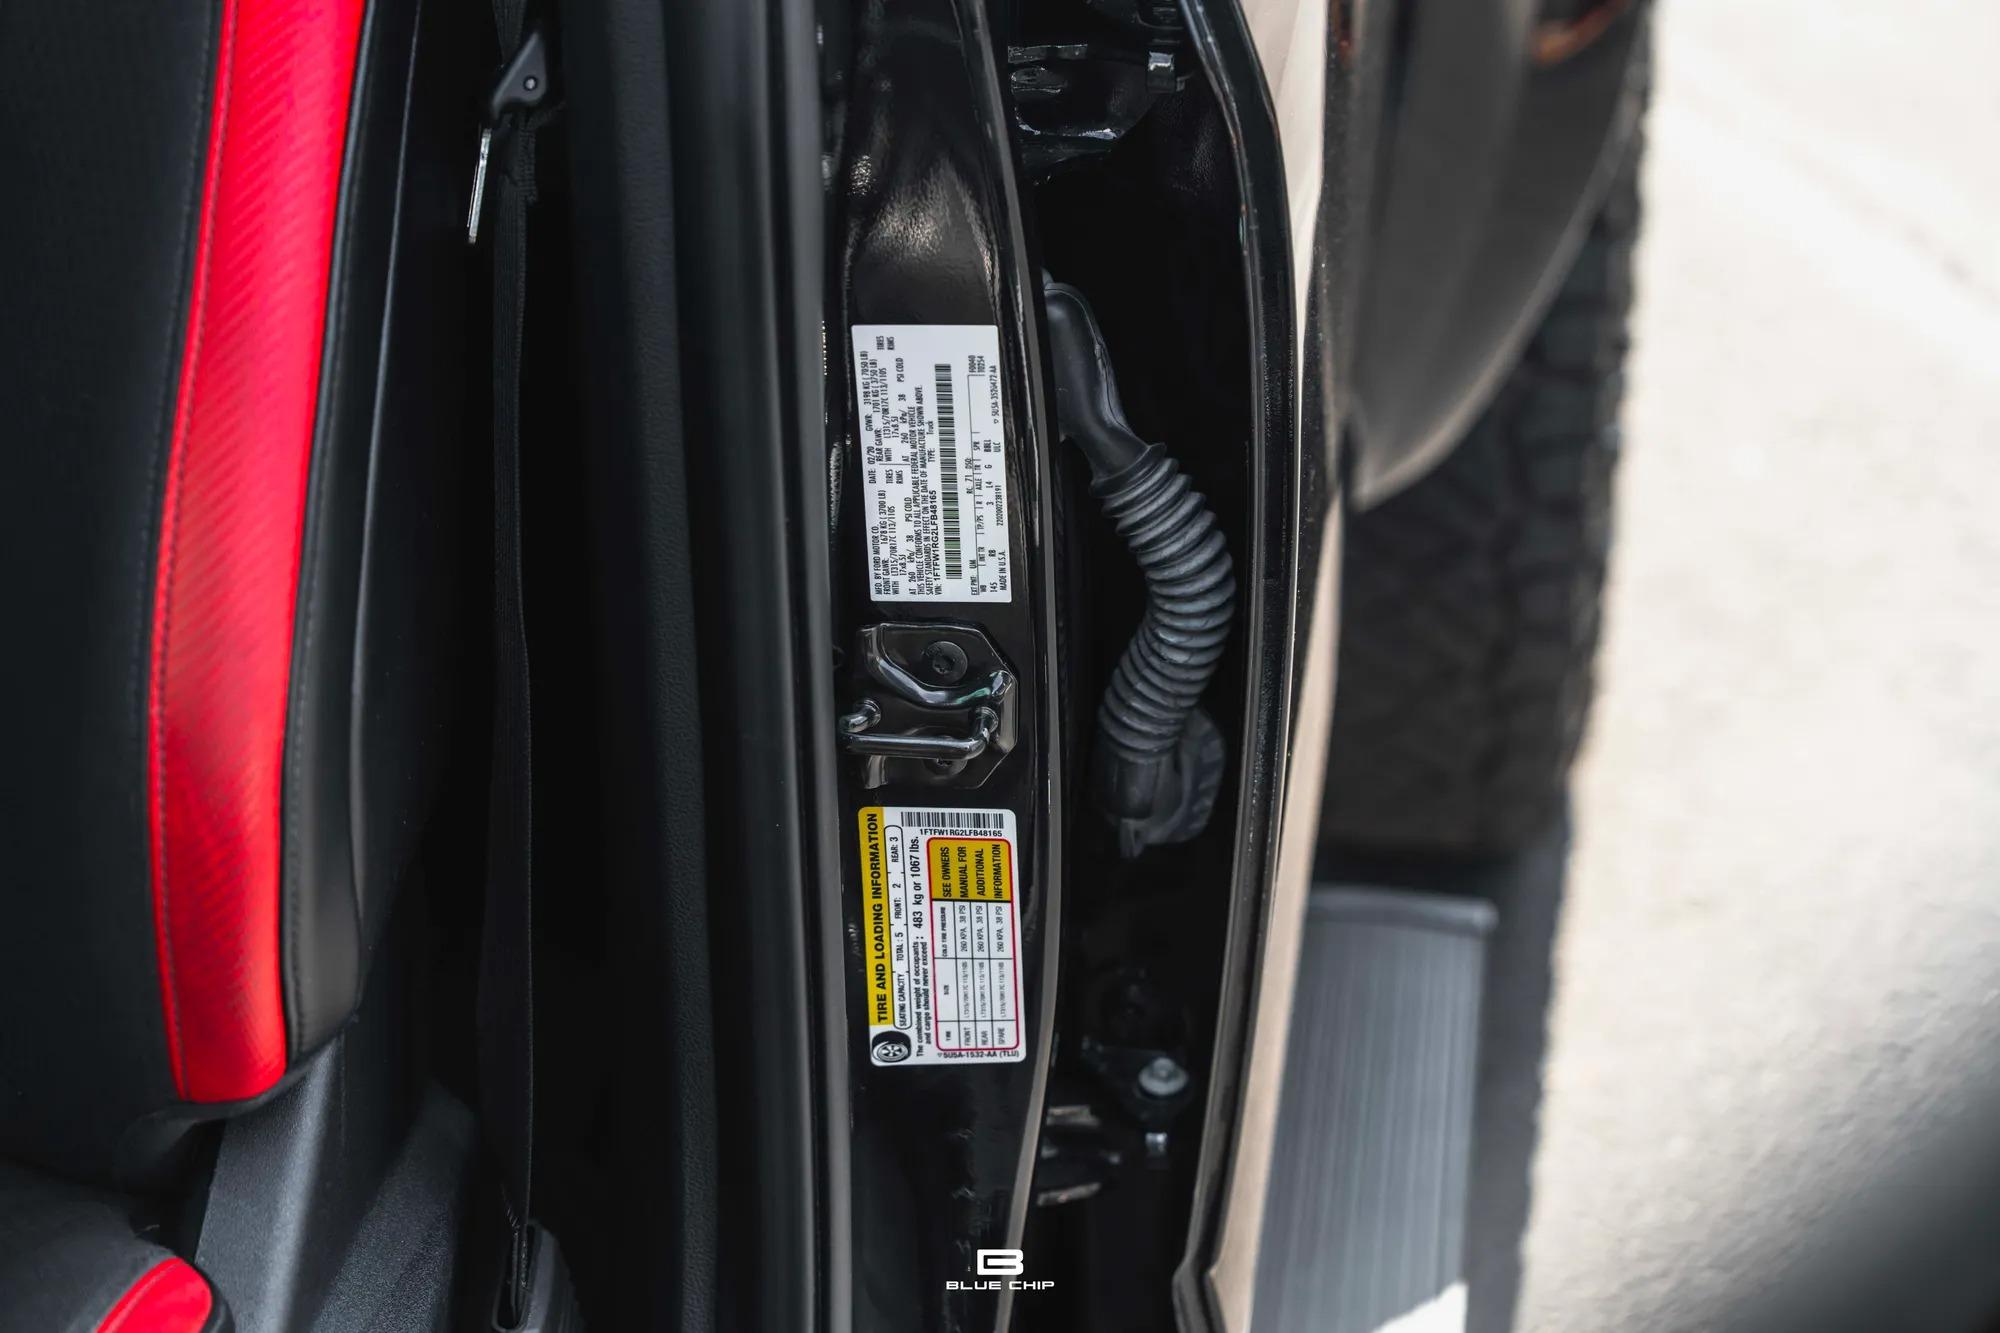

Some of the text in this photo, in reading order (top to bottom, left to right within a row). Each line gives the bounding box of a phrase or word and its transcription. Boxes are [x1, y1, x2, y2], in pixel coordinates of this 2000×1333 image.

[861, 362, 869, 376] 7050
[896, 358, 904, 372] COLD
[870, 370, 878, 384] 3750
[863, 391, 871, 405] 3198
[872, 400, 880, 412] 1701
[908, 407, 916, 428] VEHICLE
[916, 406, 924, 426] SHOWN
[925, 421, 934, 434] Truck
[900, 433, 908, 443] 260
[909, 430, 917, 449] MOTOR
[866, 446, 875, 464] 02/20
[875, 448, 883, 461] REAR
[917, 429, 927, 468] MANUFACTURE
[910, 452, 919, 474] FEDERAL
[885, 470, 893, 484] TIRES
[911, 476, 920, 507] APPLICABLE
[878, 501, 886, 514] 3700
[904, 497, 912, 512] COLD
[871, 525, 879, 534] CO.
[922, 516, 930, 534] EFFECT
[914, 529, 923, 558] CONFORMS
[928, 490, 941, 581] 1FTFW1RG2LFB48165
[872, 535, 880, 555] MOTOR
[873, 557, 881, 571] FORD
[923, 543, 932, 574] STANDARDS
[969, 560, 976, 568] UM
[916, 561, 924, 582] VEHICLE
[883, 578, 891, 594] FRONT
[892, 581, 900, 595] WITH
[925, 577, 933, 595] SAFETY
[920, 828, 1003, 837] 1FTFW1RG2LFB48165
[891, 844, 899, 862] REAR:
[909, 836, 919, 852] lbs.
[910, 855, 920, 878] 1067
[940, 847, 952, 897] SEE OWNERS
[958, 847, 969, 898] MANUAL FOR
[975, 849, 985, 896] ADDITIONAL
[992, 844, 1002, 898] INFORMATION
[913, 881, 921, 890] or
[894, 897, 902, 918] FRONT:
[912, 894, 924, 905] kg
[867, 813, 888, 1022] TIRE AND LOADING INFORMATION
[913, 911, 923, 928] 483
[912, 942, 921, 976] occupants
[897, 973, 907, 1026] SEATING CAPACITY
[914, 988, 923, 1009] weight
[915, 1012, 923, 1043] combined
